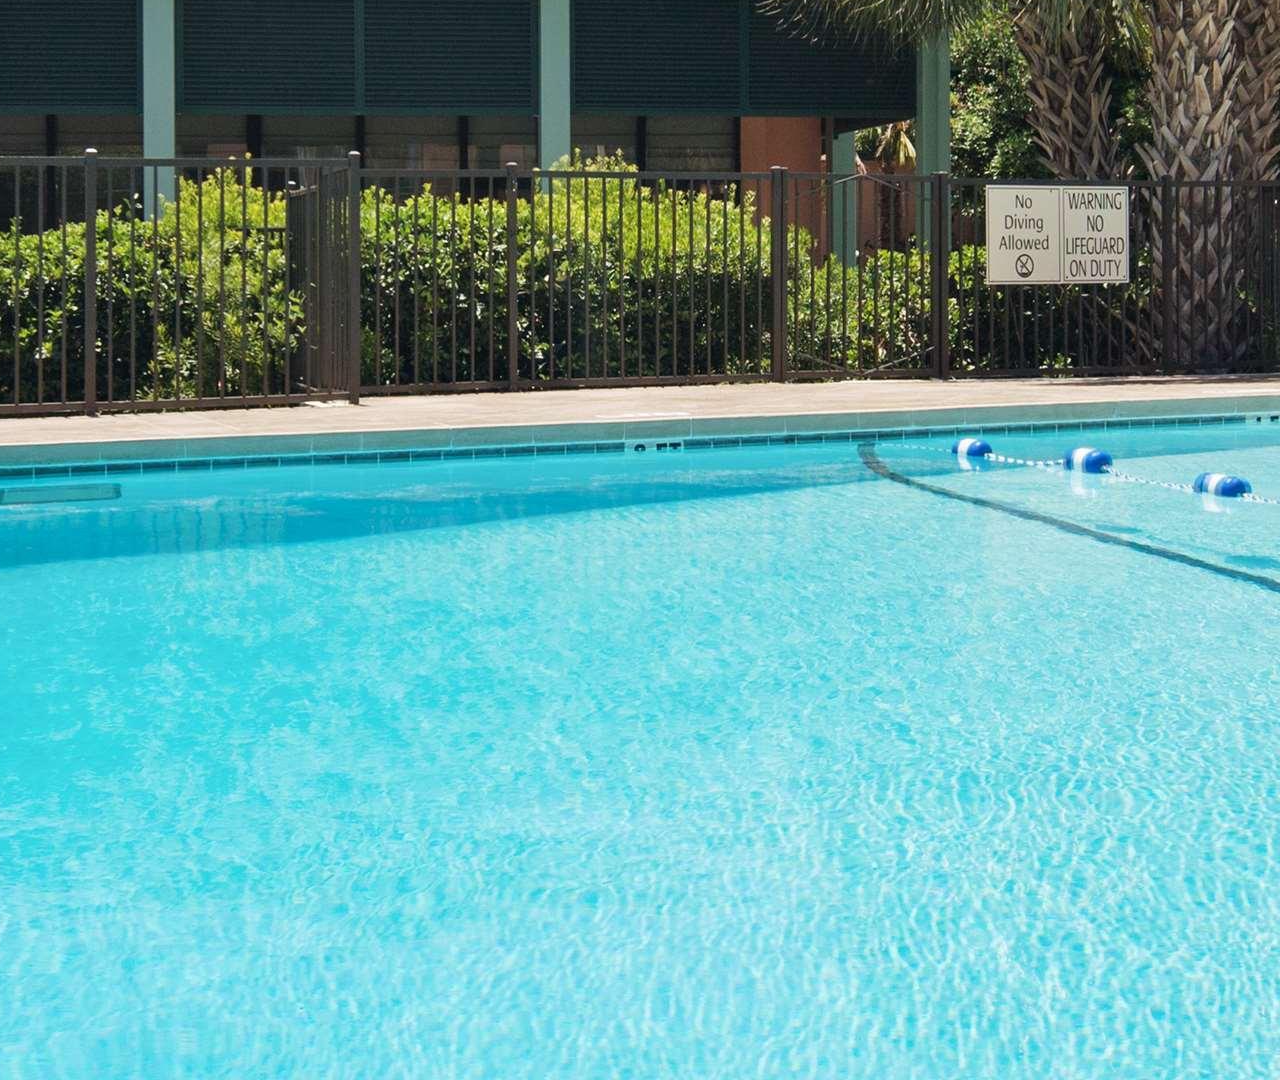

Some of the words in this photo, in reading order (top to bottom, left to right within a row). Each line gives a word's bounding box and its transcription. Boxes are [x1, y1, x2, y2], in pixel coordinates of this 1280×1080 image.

[1015, 194, 1033, 209] No
[1069, 193, 1122, 210] WARNING
[1004, 214, 1044, 232] Diving
[1086, 215, 1104, 232] NO
[999, 235, 1050, 250] Allowed
[1066, 237, 1125, 255] LIFEGUARD
[1070, 260, 1087, 277] ON
[1090, 259, 1122, 277] DUTY
